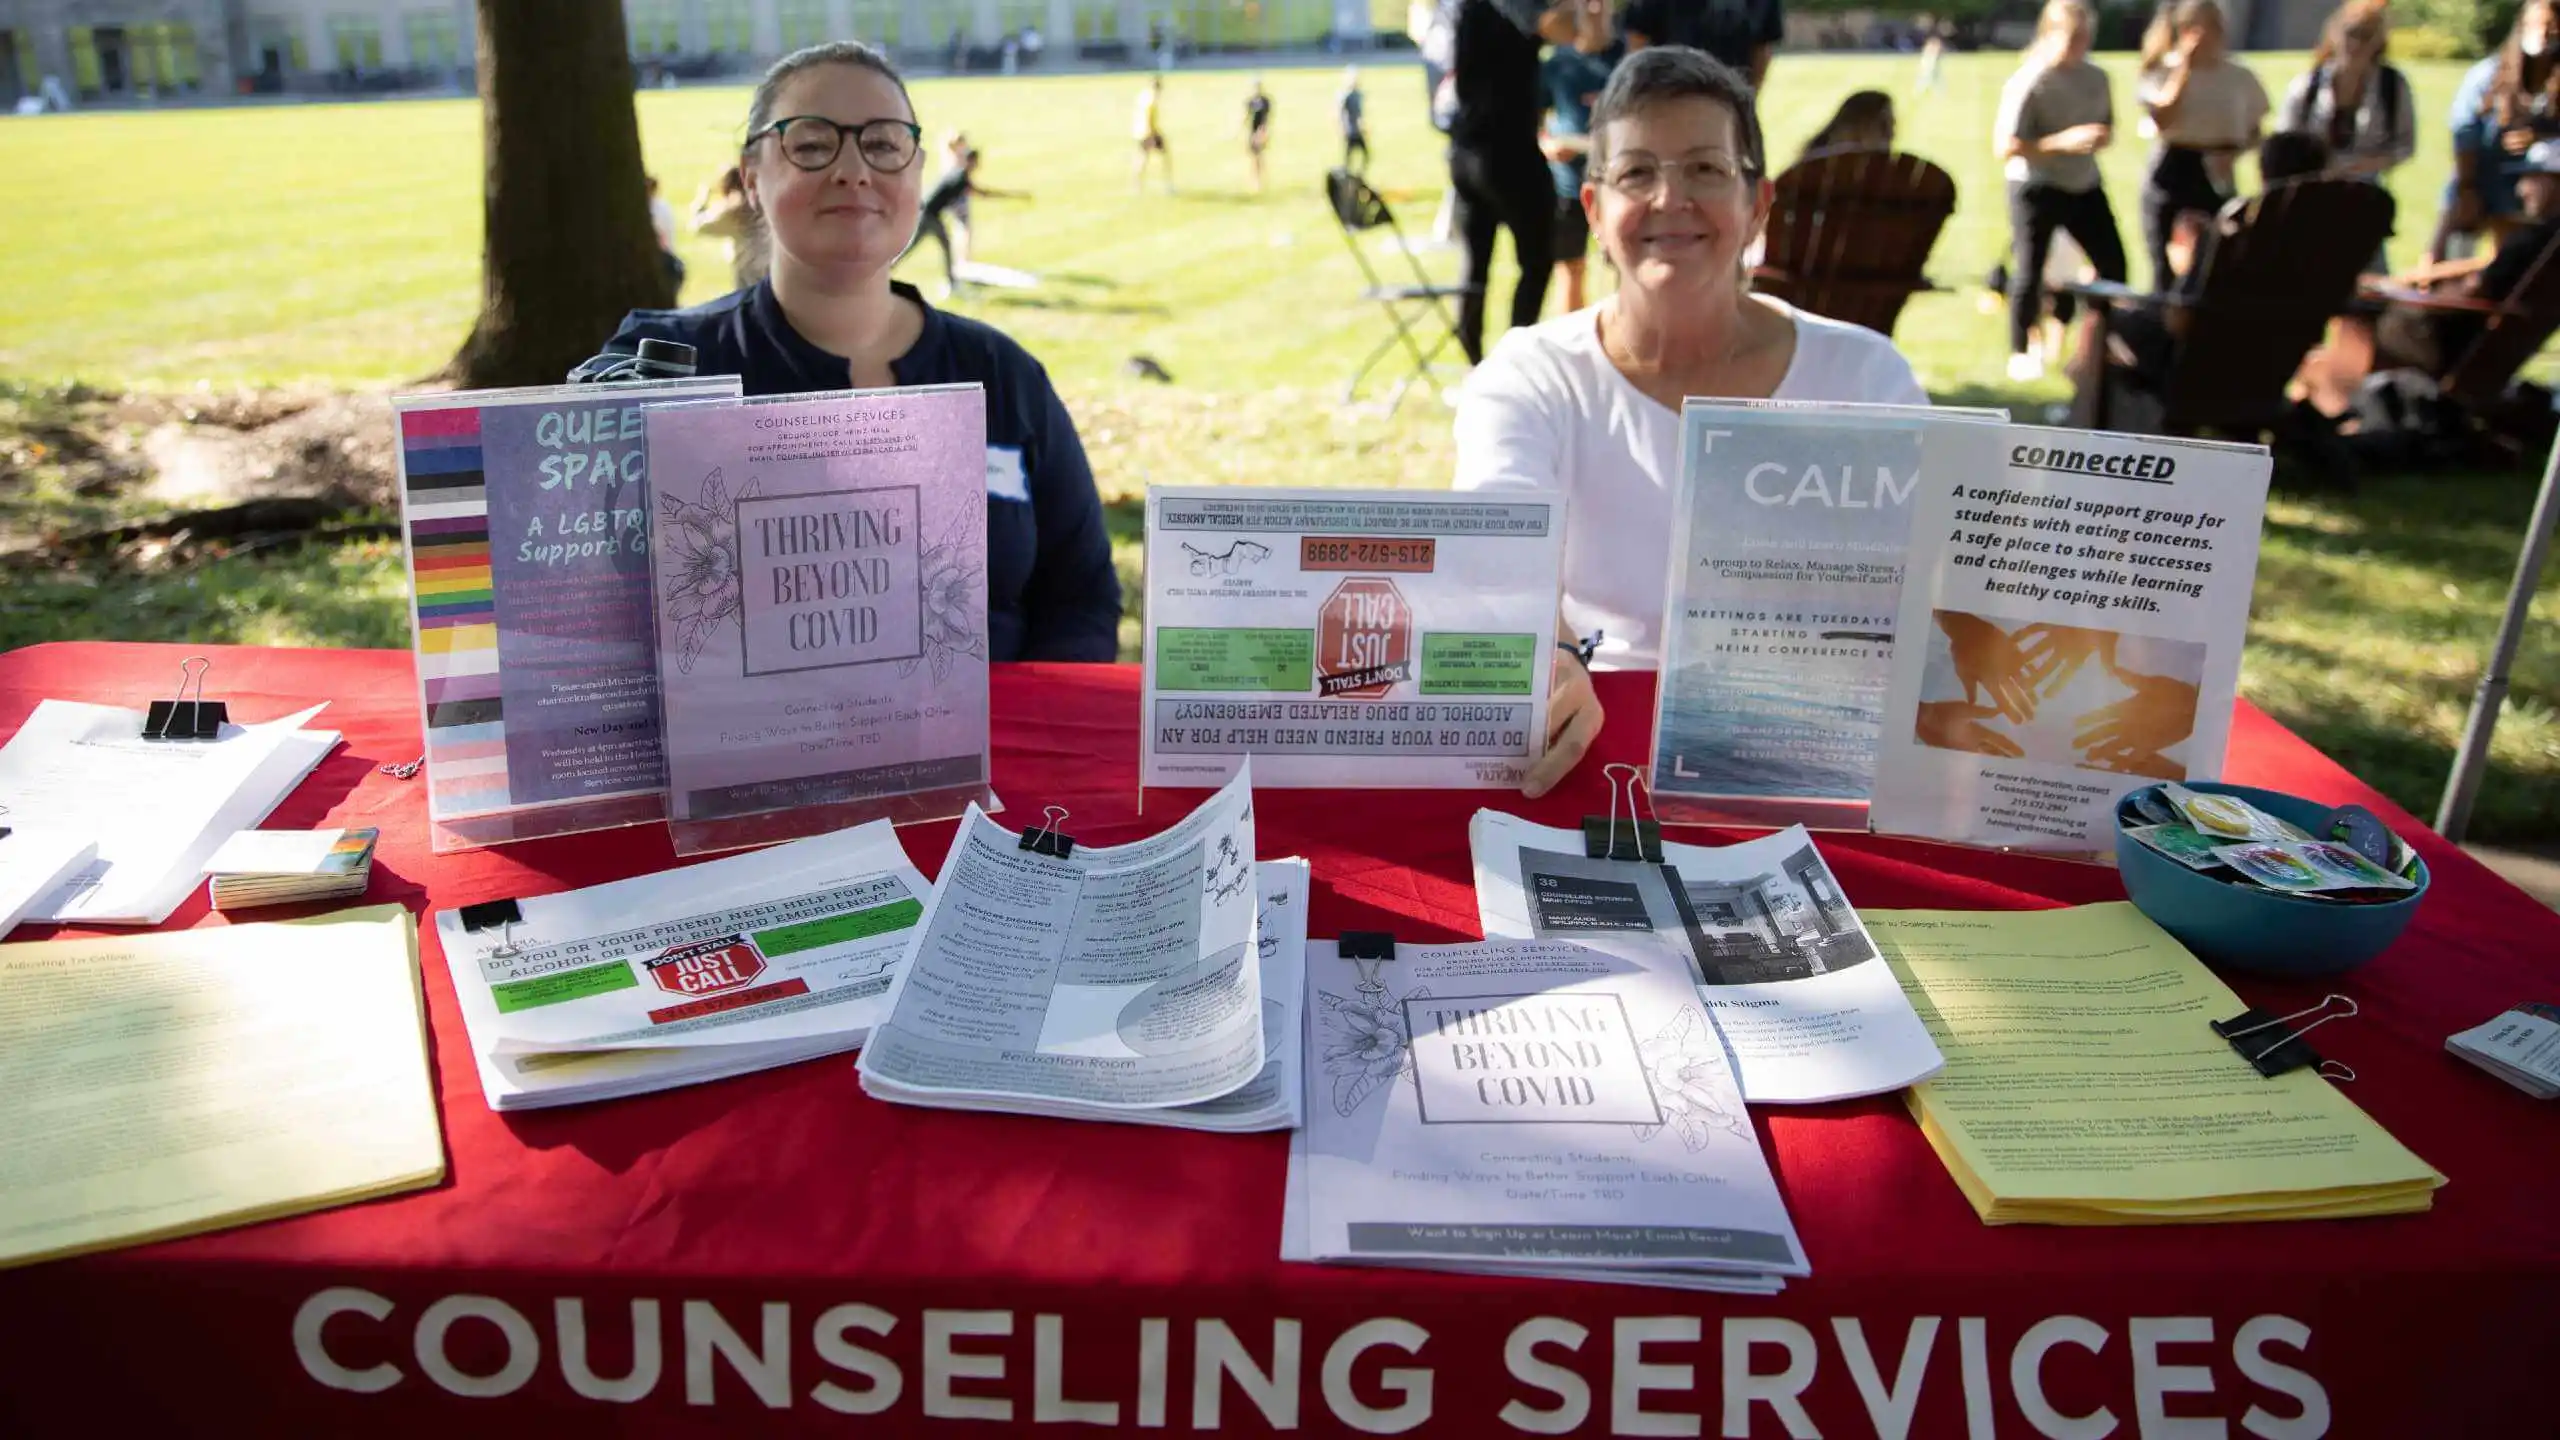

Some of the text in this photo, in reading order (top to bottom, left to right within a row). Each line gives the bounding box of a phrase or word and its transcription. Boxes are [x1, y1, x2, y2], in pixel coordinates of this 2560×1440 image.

[754, 410, 906, 429] COUNSELING SERVICES
[2010, 444, 2176, 480] connectED
[1952, 484, 2225, 530] A confidential support group for
[528, 517, 543, 537] A
[1208, 514, 1243, 525] MEDICAL
[1264, 516, 1293, 526] ACTION
[1294, 516, 1349, 527] DISCIPLINARY
[1364, 518, 1399, 527] SUBJECT
[1412, 519, 1429, 528] NOT
[1432, 519, 1450, 529] WILL
[1453, 519, 1483, 529] FRIEND
[1485, 519, 1506, 530] YOUR
[1507, 520, 1525, 530] AND
[1527, 520, 1543, 530] YOU
[1954, 507, 2214, 551] students with eating concerns.
[755, 508, 900, 557] THRIVING
[517, 537, 620, 566] Support
[1950, 529, 2213, 573] A safe place to share successes
[1700, 558, 1709, 567] A
[1712, 559, 1747, 569] group
[1750, 560, 1762, 568] to
[1806, 560, 1854, 573] Manage
[1953, 551, 2204, 598] and challenges while learning
[772, 557, 890, 605] BEYOND
[1721, 568, 1892, 584] Compassion for Yourself and
[1984, 577, 2161, 613] healthy coping skills.
[1337, 591, 1395, 630] CALL
[1687, 610, 1892, 626] MEETINGS ARE TUESDAYS
[789, 606, 878, 652] COVID
[1730, 628, 1808, 639] STARTING
[1337, 632, 1392, 669] JUST
[1715, 644, 1868, 658] HEINZ CONFERENCE
[1326, 672, 1362, 693] STALL
[1364, 664, 1404, 685] DON'T
[1175, 704, 1513, 722] ALCOHOL OR DRUG RELATED EMERGENCY?
[575, 720, 648, 736] New Day and
[1162, 728, 1523, 746] DO YOU OR YOUR FRIEND NEED HELP FOR AN
[1994, 783, 2078, 803] Counseling Services
[1996, 773, 2019, 782] more
[2020, 775, 2074, 791] information,
[2076, 784, 2111, 795] contact
[969, 842, 1027, 873] Counseling
[972, 835, 1020, 863] Welcome
[1039, 862, 1083, 875] Arcadia
[1539, 878, 1558, 887] 38
[1541, 891, 1593, 900] COUNSELING
[487, 880, 897, 970] DO YOU OR YOUR FRIEND NEED HELP FOR AN
[963, 902, 1052, 928] Services provided
[509, 954, 596, 978] ALCOHOL
[601, 948, 625, 959] OR
[633, 935, 684, 952] DRUG
[689, 918, 768, 941] RELATED
[776, 892, 888, 923] EMERGENCY?
[5, 956, 66, 971] Adjusting
[88, 952, 137, 965] College
[651, 937, 737, 967] DON'T STALL
[1420, 947, 1516, 959] COUNSELING
[676, 949, 735, 978] JUST
[677, 966, 752, 995] CALL
[1730, 1000, 1780, 1008] Stigma
[1427, 1007, 1608, 1036] THRIVING
[1000, 1051, 1136, 1070] Relaxation Room
[1451, 1040, 1603, 1071] BEYOND
[1476, 1076, 1596, 1107] COVID
[1480, 1152, 1563, 1165] Connecting
[1392, 1170, 1727, 1186] Finding Ways to Better Support Each Other
[1505, 1188, 1624, 1200] Date/Time TBD
[1407, 1226, 1685, 1242] Want to Sign Up Learn More? Email
[293, 1286, 1436, 1433] COUNSELING
[1498, 1314, 2332, 1440] SERVICES
